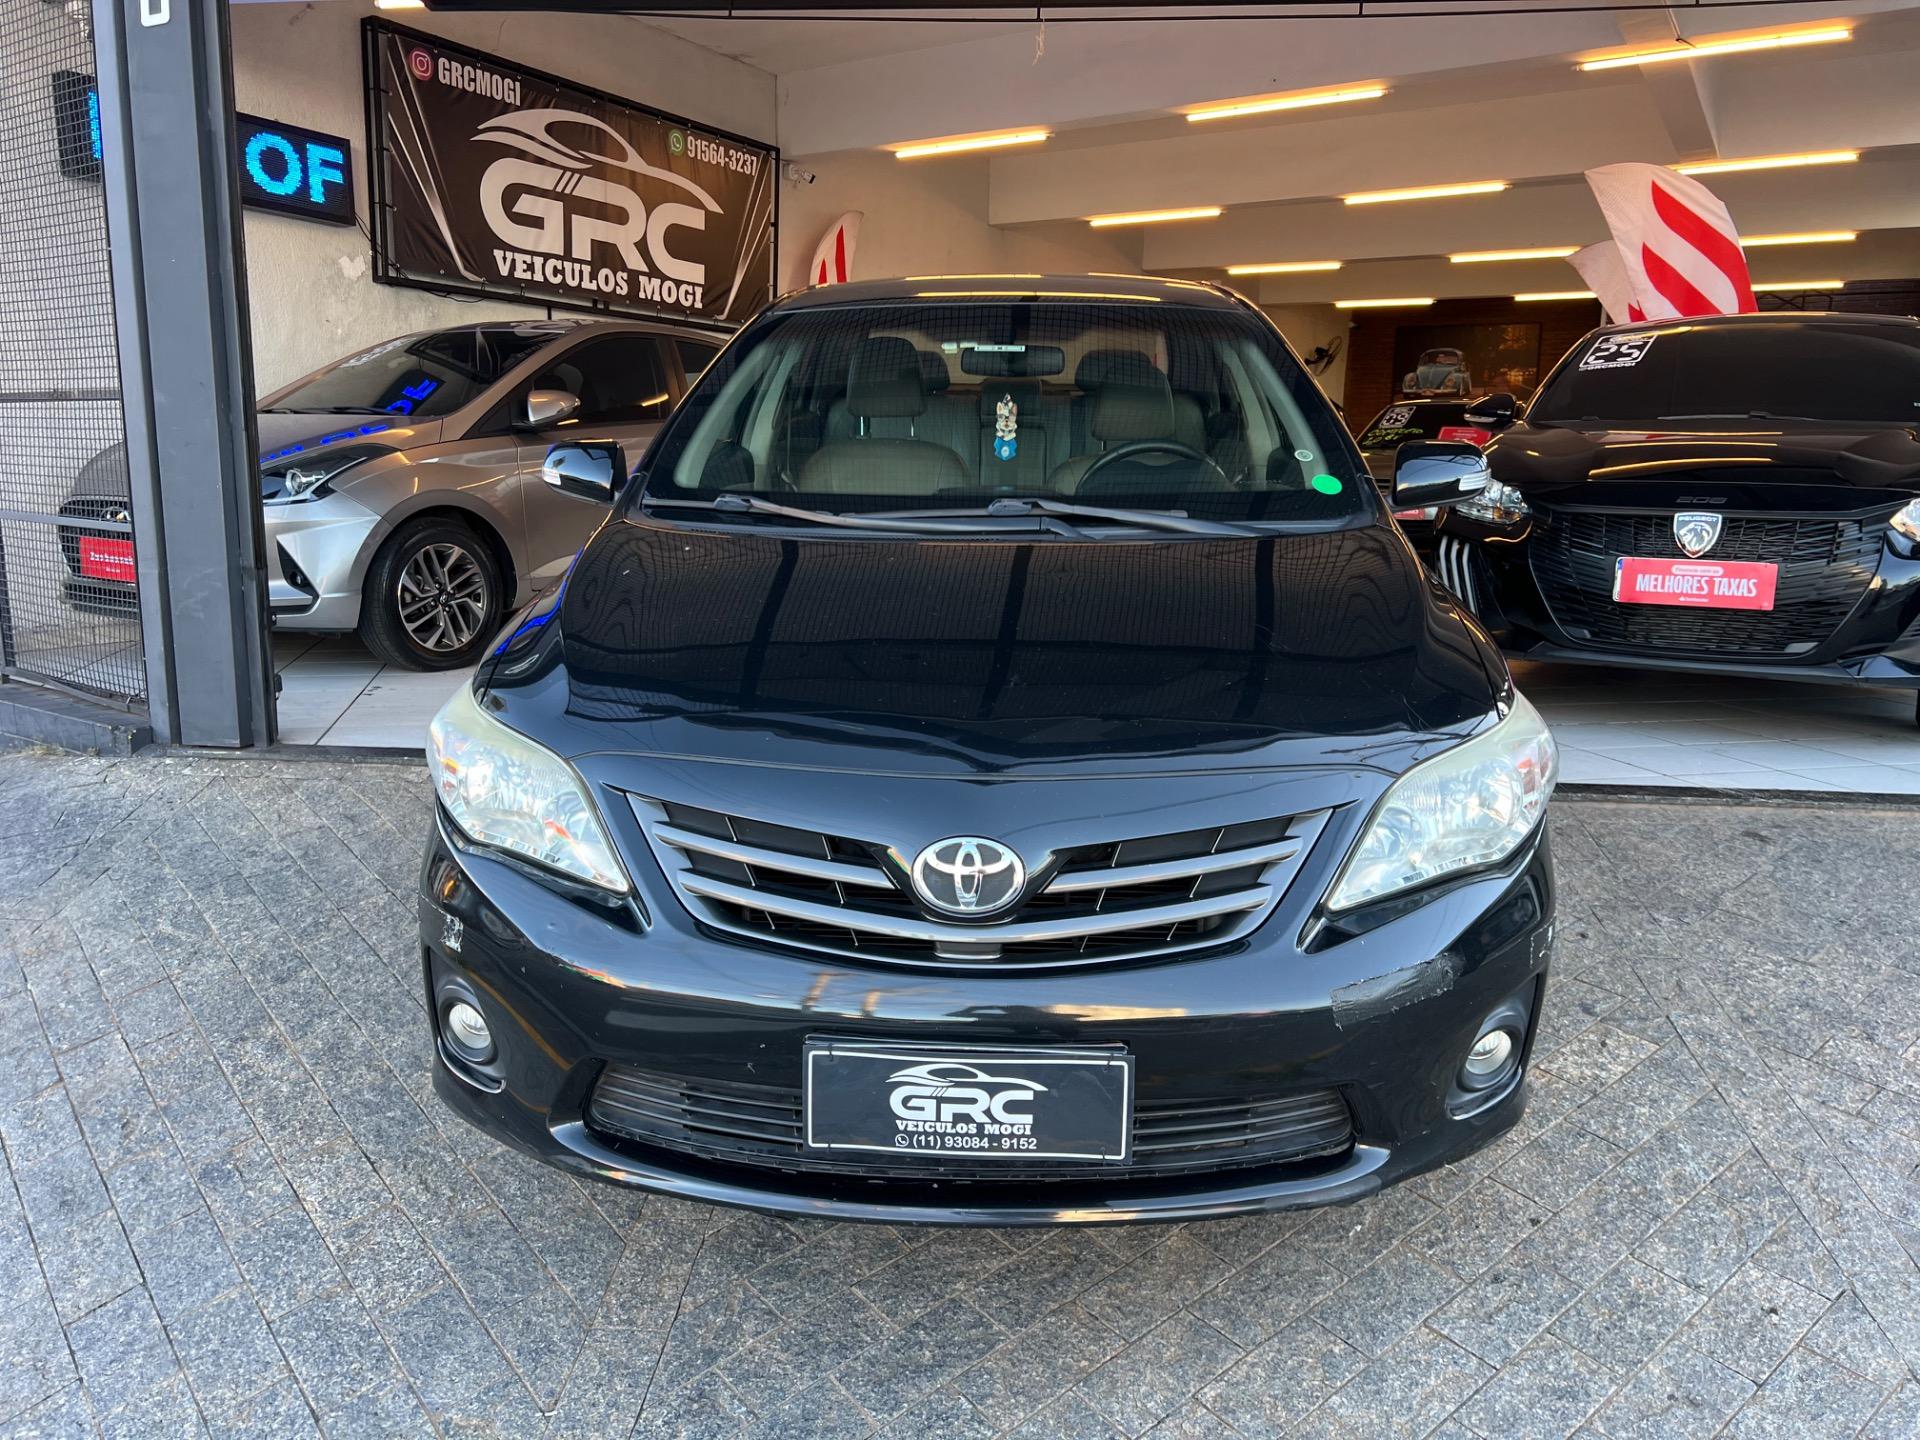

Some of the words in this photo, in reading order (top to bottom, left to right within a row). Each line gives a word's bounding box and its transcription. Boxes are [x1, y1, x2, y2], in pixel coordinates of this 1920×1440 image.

[438, 57, 521, 107] GRCMOGI
[245, 131, 345, 203] OF
[686, 136, 758, 177] 91564-3237
[479, 157, 705, 285] GRC
[493, 249, 629, 296] VEICULOS
[638, 275, 703, 309] MOGI
[1586, 341, 1644, 364] 25
[1635, 574, 1710, 595] MELHORES
[1713, 577, 1758, 597] TAXAS
[889, 1086, 1034, 1124] GRC
[895, 1119, 977, 1135] VEICULOS
[984, 1123, 1032, 1136] MOGI
[912, 1135, 941, 1149] (11)
[944, 1136, 989, 1149] 93084
[1001, 1137, 1037, 1150] 9152
